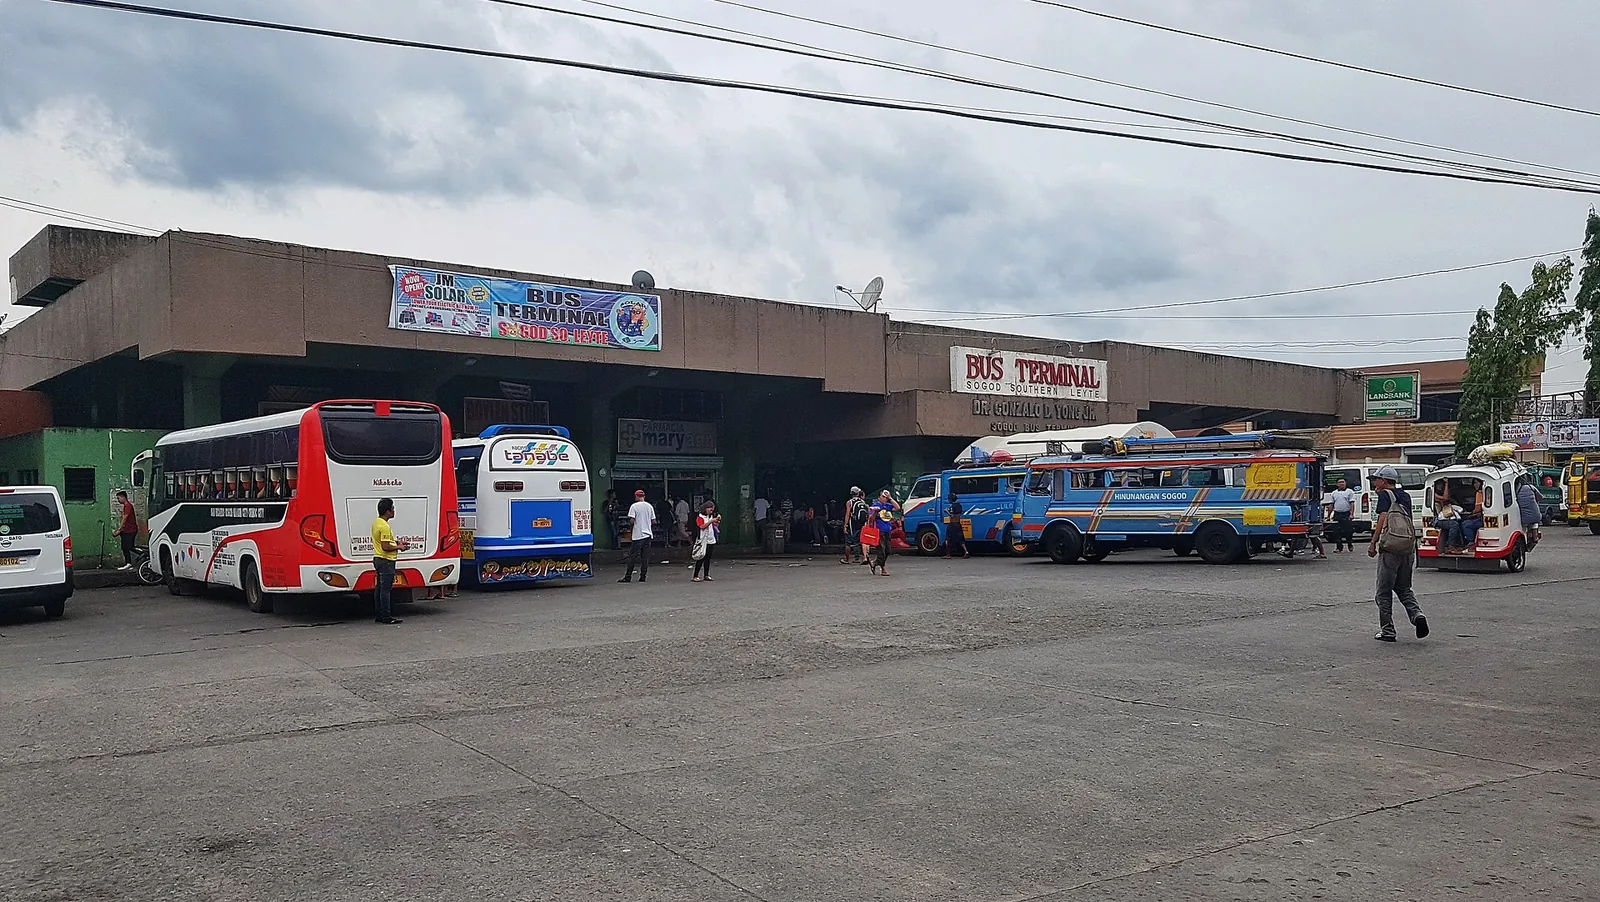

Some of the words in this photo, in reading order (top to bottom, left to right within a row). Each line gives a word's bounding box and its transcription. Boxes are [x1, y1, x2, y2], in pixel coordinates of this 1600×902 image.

[404, 276, 419, 285] NOW
[436, 273, 454, 287] JM
[424, 285, 466, 303] SOLAR
[526, 288, 581, 307] BUS
[494, 302, 608, 327] TERMINAL
[551, 327, 571, 342] SO.
[574, 329, 609, 345] LEYTE
[966, 354, 1003, 381] BUS
[1015, 358, 1101, 389] TERMINAL
[966, 381, 1001, 392] SOGOD
[1010, 383, 1058, 396] SOUTHERN
[1070, 389, 1100, 399] LEYTE
[1368, 391, 1411, 400] LANDBANK
[972, 399, 991, 416] DR.
[993, 400, 1040, 418] GONZALO
[1055, 404, 1081, 421] YONG
[504, 449, 570, 462] tanabe
[1114, 493, 1160, 501] HINUNANGAN
[1162, 492, 1187, 500] SOGOD
[1484, 516, 1499, 528] 112
